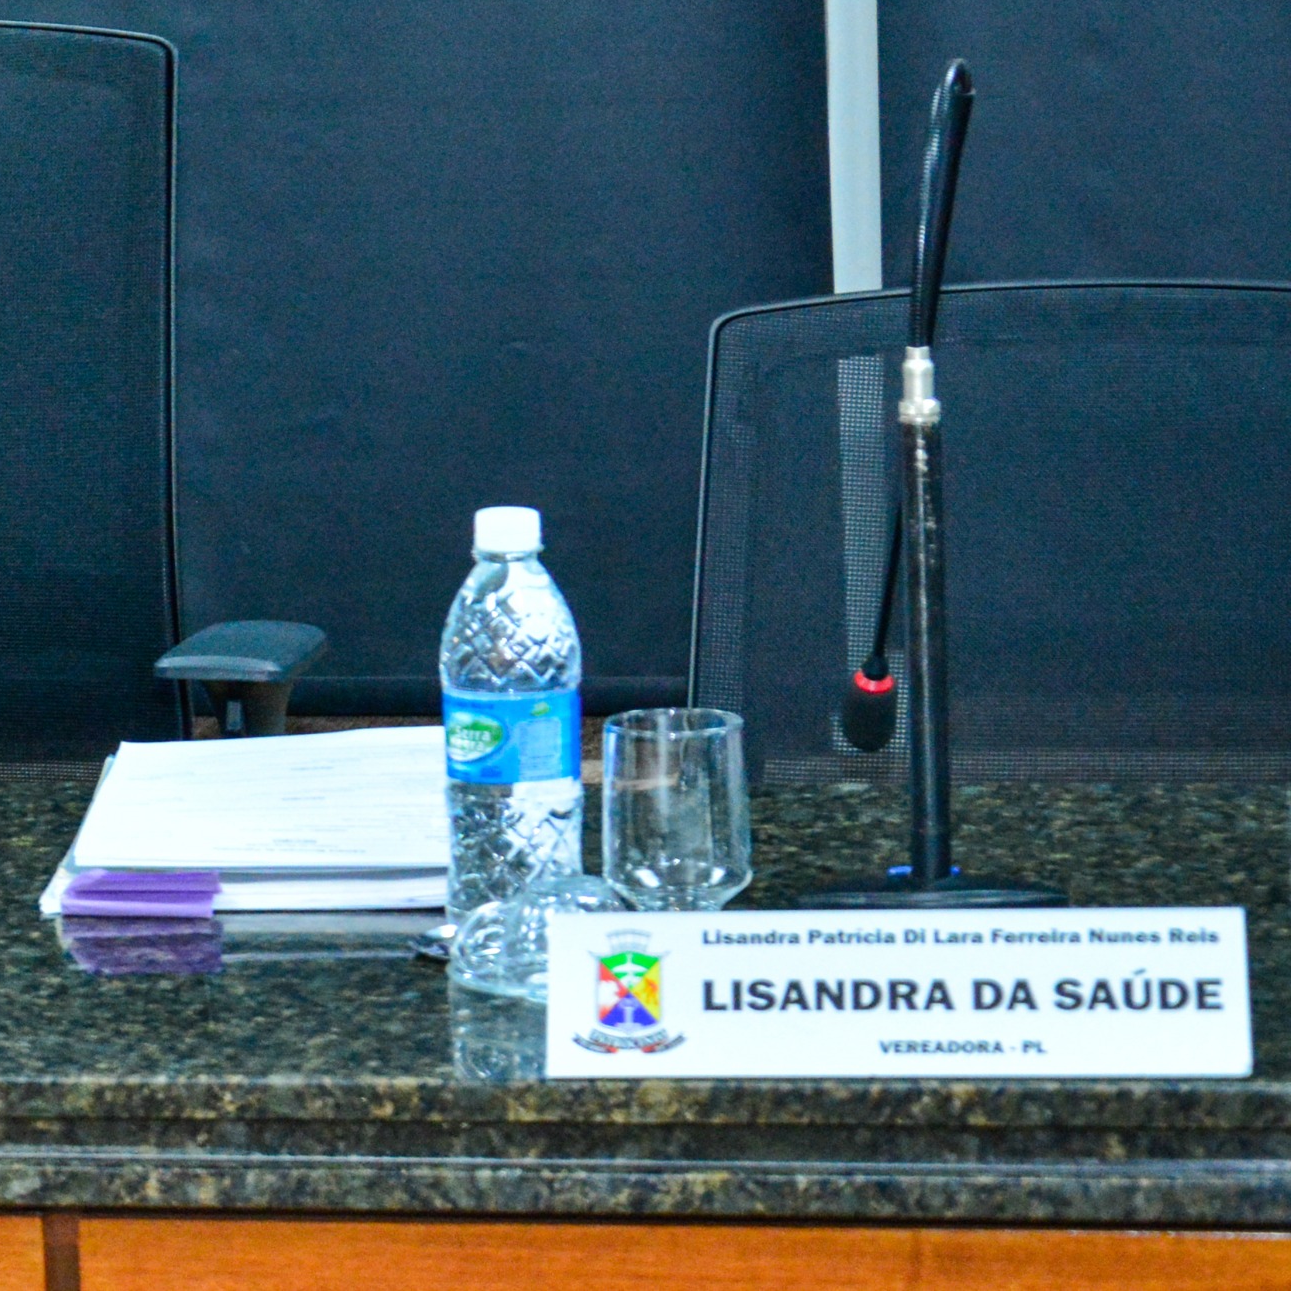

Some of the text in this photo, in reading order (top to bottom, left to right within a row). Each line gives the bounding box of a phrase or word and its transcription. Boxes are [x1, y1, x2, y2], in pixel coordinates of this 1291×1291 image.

[702, 930, 800, 945] Lisandra
[903, 929, 926, 944] Di
[933, 930, 983, 944] Lara
[990, 928, 1081, 944] Ferreira
[1088, 928, 1161, 944] Nunes
[1168, 928, 1219, 943] Reis
[703, 969, 1224, 1012] LISANDRA DA SAÚDE
[879, 1041, 1004, 1054] VEREADORA
[1022, 1041, 1047, 1054] PL
